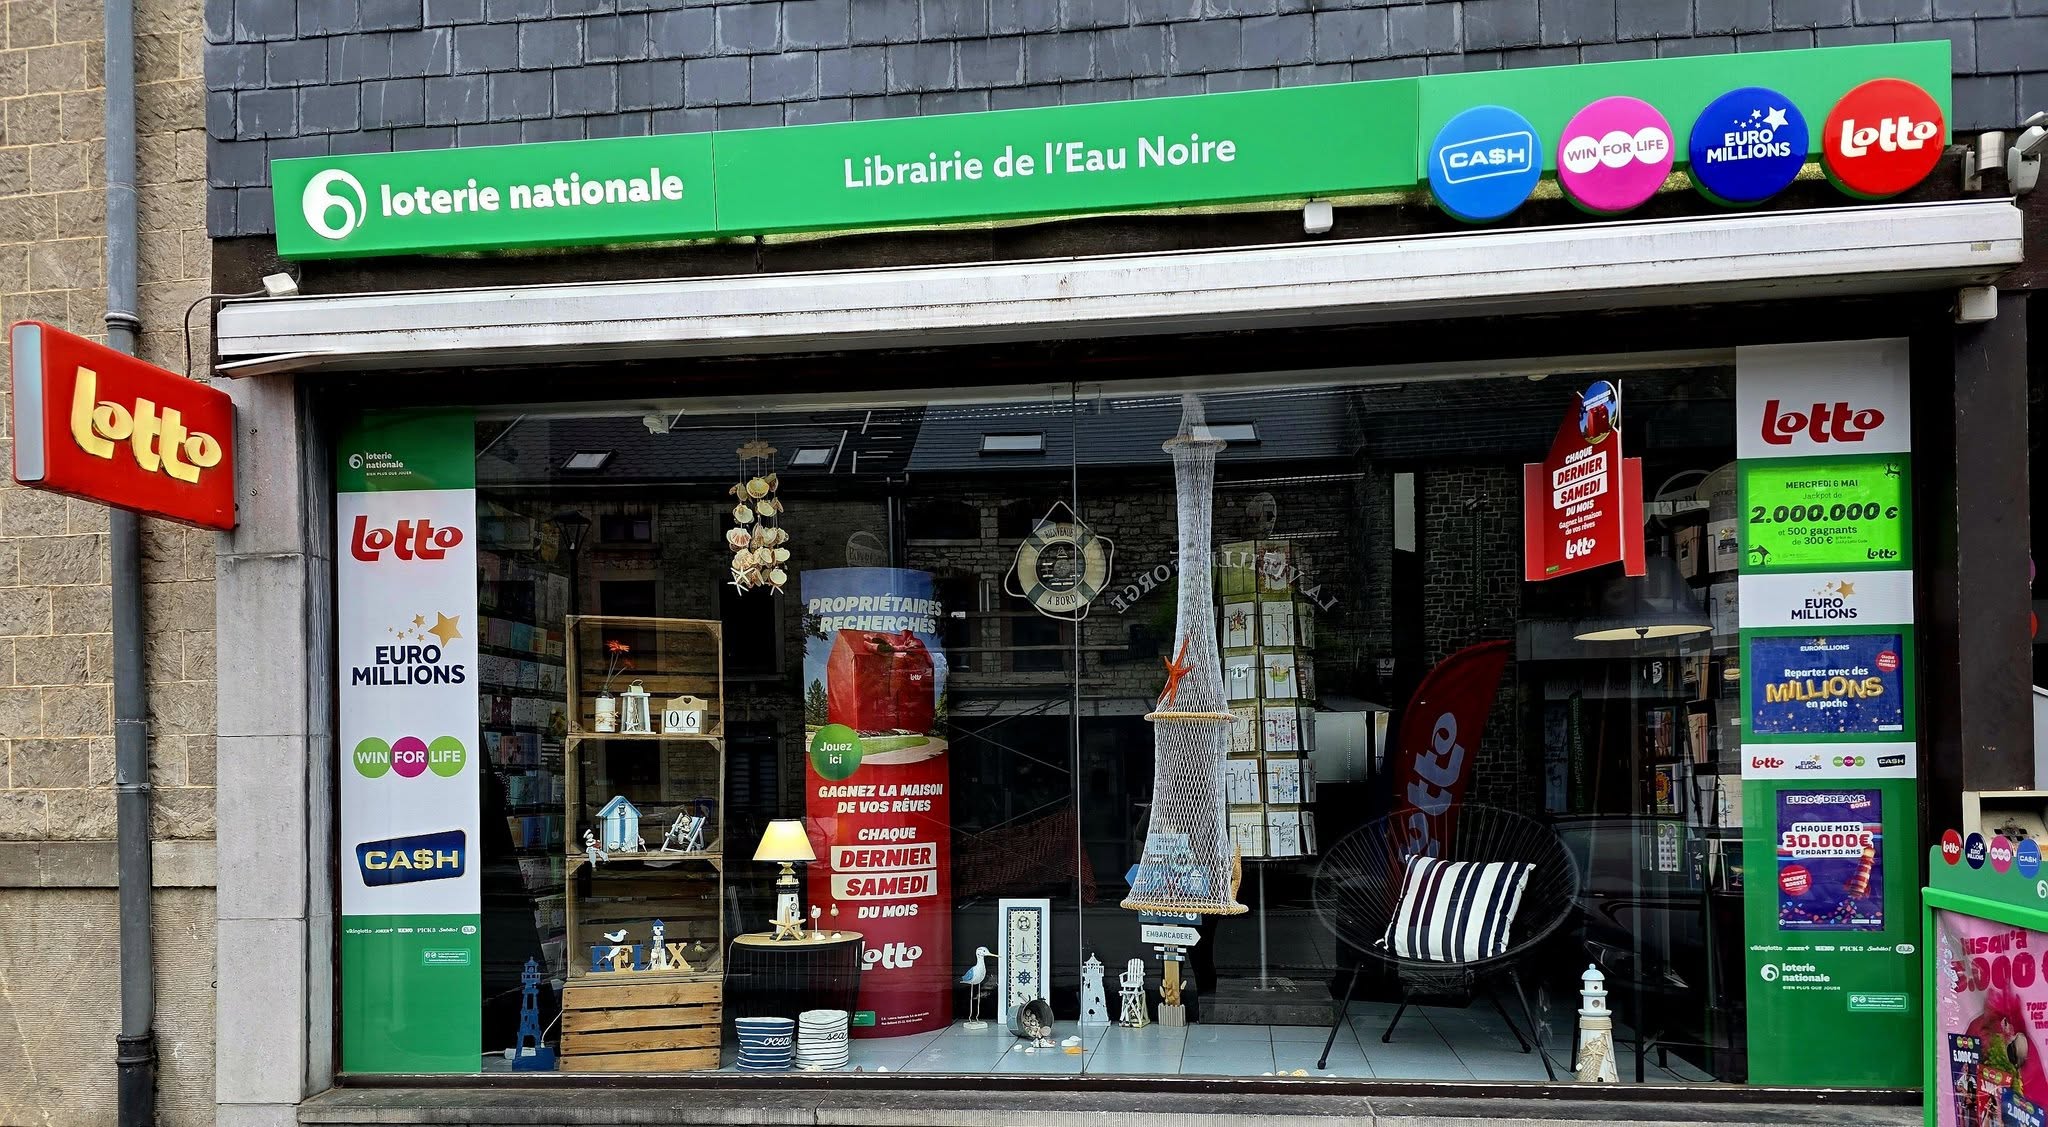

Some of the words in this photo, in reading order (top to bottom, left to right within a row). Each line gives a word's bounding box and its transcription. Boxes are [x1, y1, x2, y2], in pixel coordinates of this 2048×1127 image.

[1724, 129, 1774, 147] EURO
[1567, 147, 1598, 162] WIN
[1603, 143, 1632, 156] FOR
[1637, 139, 1664, 153] LIFE
[1707, 142, 1791, 163] MILLIONS
[844, 151, 983, 188] Librairie
[993, 145, 1034, 177] de
[1045, 141, 1127, 174] l'Eau
[1138, 133, 1237, 168] Noire
[381, 178, 499, 217] loterie
[509, 167, 684, 209] nationale
[366, 452, 392, 460] loterie
[1565, 446, 1593, 465] CHAQUE
[366, 460, 404, 469] nationale
[1557, 457, 1603, 486] DERNIER
[1560, 478, 1601, 505] SAMEDI
[1786, 480, 1831, 489] MERCREDI
[1833, 480, 1839, 488] 6
[1841, 479, 1858, 487] MAI
[1803, 492, 1831, 500] Jackpot
[1833, 491, 1842, 499] de
[1566, 505, 1576, 517] DU
[1576, 499, 1595, 514] MOIS
[1583, 510, 1602, 521] maison
[1749, 502, 1881, 524] 2.000.000
[1884, 506, 1899, 520] €
[1788, 526, 1808, 536] 500
[1810, 525, 1858, 538] gagnants
[1804, 536, 1824, 546] 300
[1826, 536, 1834, 545] €
[808, 593, 943, 617] PROPRIÉTAIRES
[1804, 598, 1844, 609] EURO
[1791, 608, 1858, 620] MILLIONS
[820, 614, 937, 634] RECHERCHÉS
[375, 645, 442, 665] EURO
[352, 664, 466, 686] MILLIONS
[1784, 667, 1827, 678] Repartez
[1828, 667, 1850, 676] avec
[1851, 665, 1869, 676] des
[1766, 677, 1884, 703] MILLIONS
[1806, 700, 1818, 708] en
[1820, 698, 1848, 710] poche
[820, 741, 852, 752] Jouez
[357, 752, 388, 764] WIN
[394, 751, 425, 763] FOR
[431, 751, 461, 763] LIFE
[829, 754, 842, 764] ici
[818, 785, 877, 798] GAGNEZ
[879, 784, 897, 797] LA
[900, 783, 943, 796] MAISON
[837, 802, 856, 814] DE
[859, 801, 889, 813] VOS
[892, 798, 931, 813] RÊVES
[858, 827, 917, 842] CHAQUE
[1835, 824, 1861, 832] MOIS
[840, 847, 932, 868] DERNIER
[845, 874, 929, 897] SAMEDI
[858, 906, 879, 919] DU
[882, 903, 919, 918] MOIS
[1146, 930, 1193, 941] EMBARCADERE
[1782, 963, 1816, 973] loterie
[1782, 973, 1831, 983] nationale
